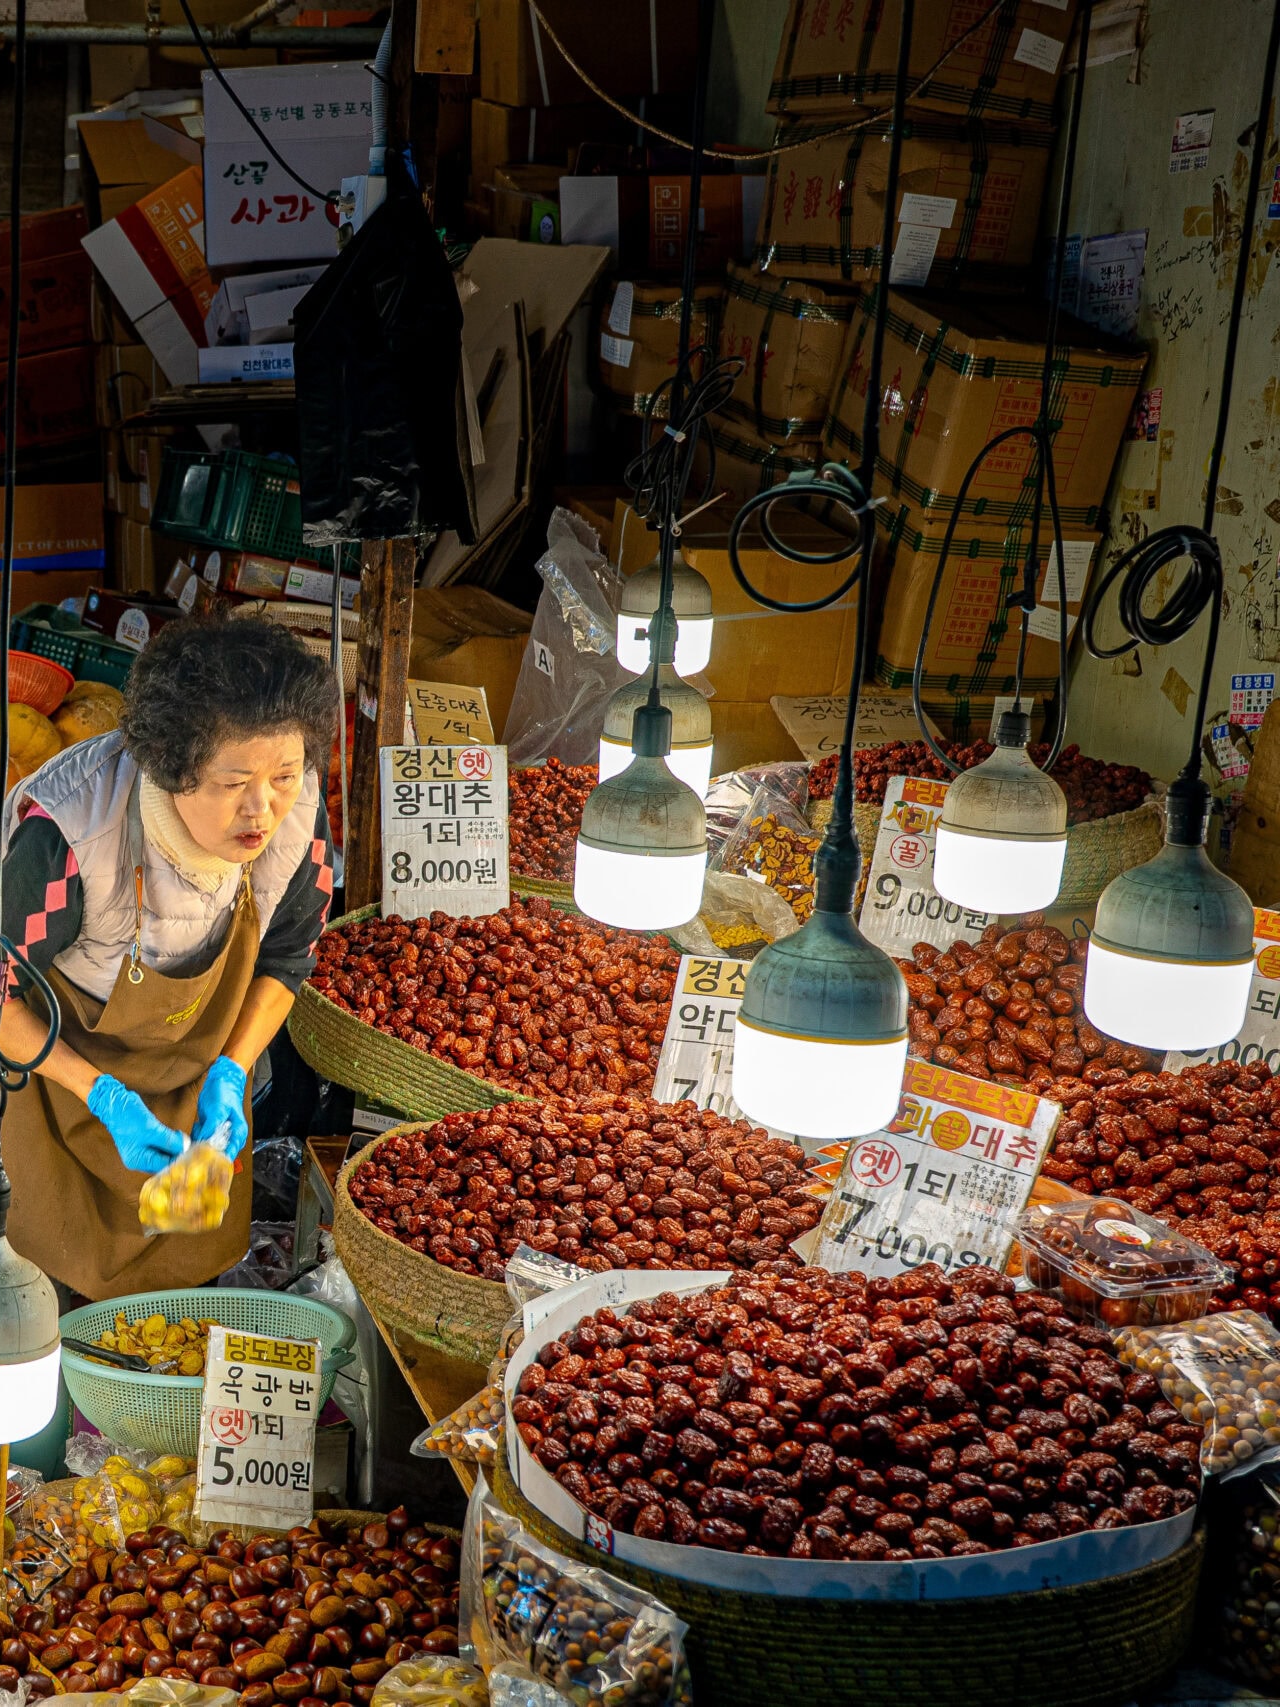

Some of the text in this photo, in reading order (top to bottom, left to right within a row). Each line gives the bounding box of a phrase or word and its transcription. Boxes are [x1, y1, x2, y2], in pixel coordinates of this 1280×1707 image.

[223, 160, 268, 186] 산골
[231, 194, 315, 224] 사과
[416, 688, 481, 721] 토종대추
[395, 749, 490, 780] 경산 햇
[393, 782, 493, 816] 왕대추
[422, 819, 462, 846] 1되
[894, 836, 924, 867] 꿀
[391, 851, 498, 888] 8,000원
[873, 873, 989, 931] 9,000원
[854, 1142, 957, 1206] 햇 1되
[226, 1333, 315, 1372] 당도보장
[215, 1407, 284, 1443] 햇 1되
[212, 1446, 311, 1492] 5,000원
